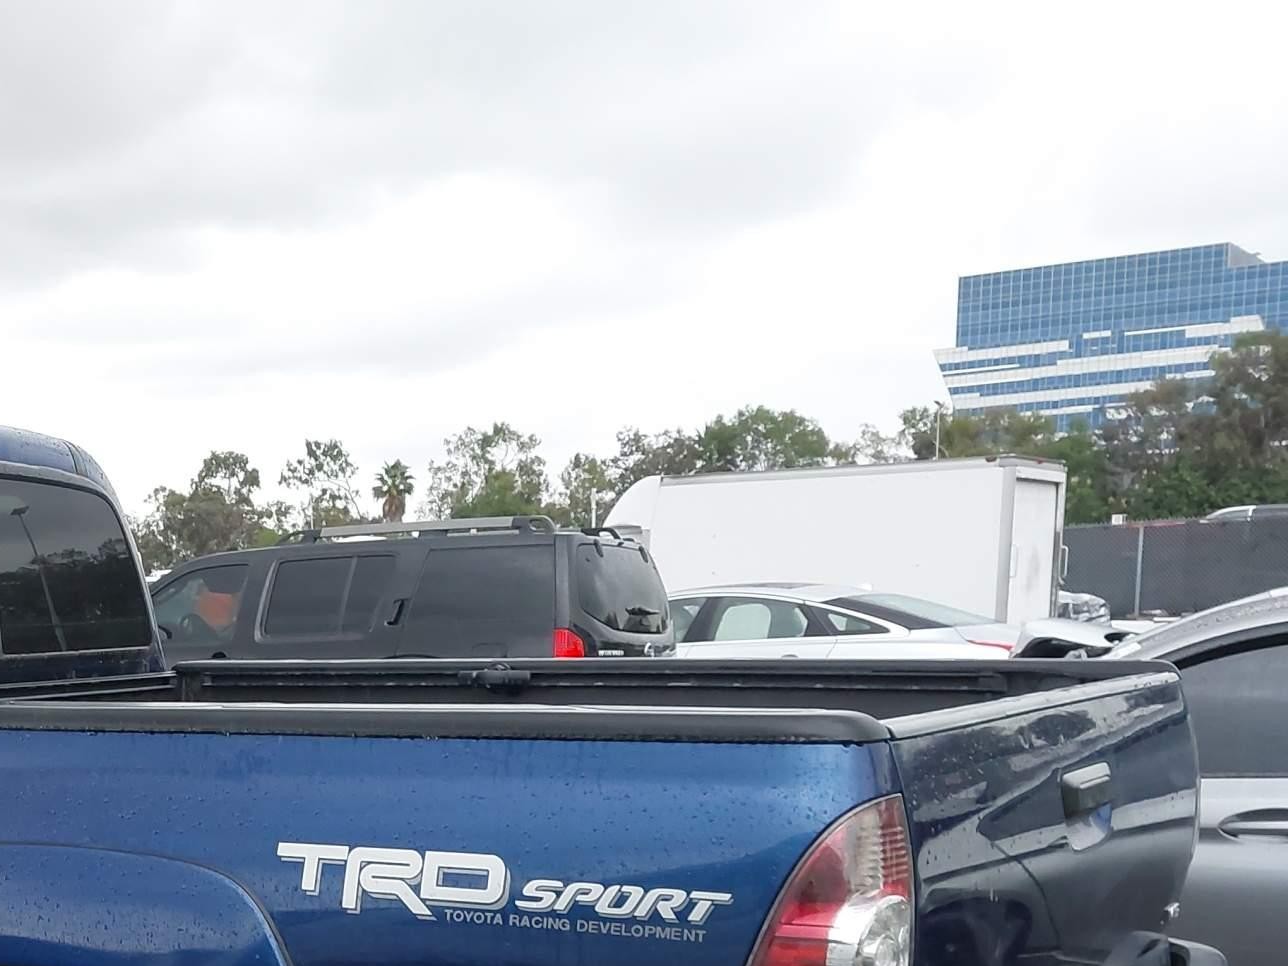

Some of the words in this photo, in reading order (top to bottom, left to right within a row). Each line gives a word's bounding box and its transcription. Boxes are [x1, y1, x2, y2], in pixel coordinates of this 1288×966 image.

[277, 841, 511, 921] TRD
[515, 879, 731, 925] SPORT
[444, 908, 503, 926] TOYOTA
[508, 914, 571, 932] RACING
[576, 919, 707, 943] DEVELOPMENT
